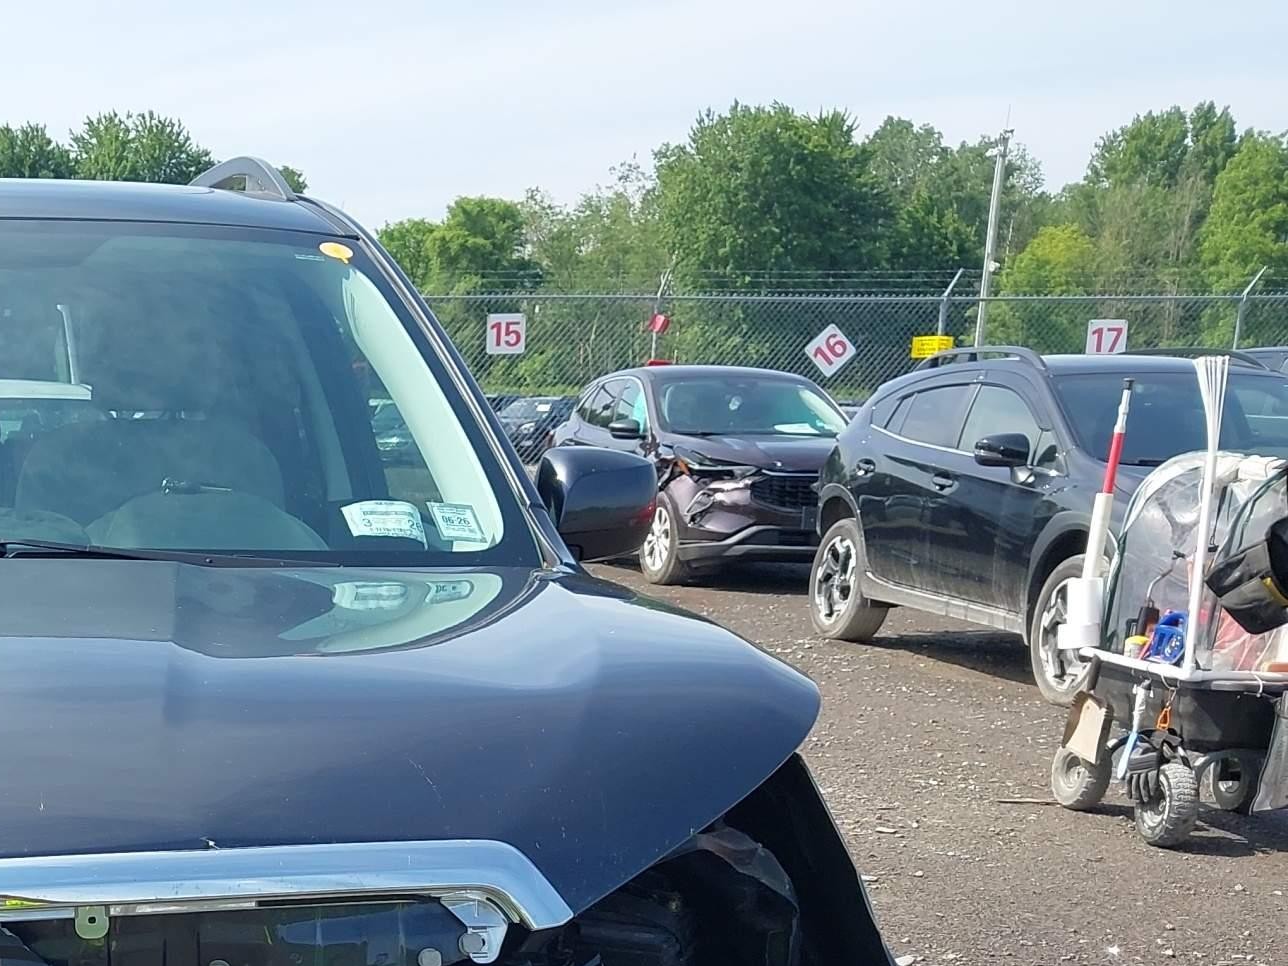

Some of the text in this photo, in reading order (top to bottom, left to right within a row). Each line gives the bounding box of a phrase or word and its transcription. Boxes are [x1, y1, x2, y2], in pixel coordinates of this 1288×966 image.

[490, 321, 521, 347] 15
[1092, 327, 1123, 352] 17
[813, 333, 847, 366] 16
